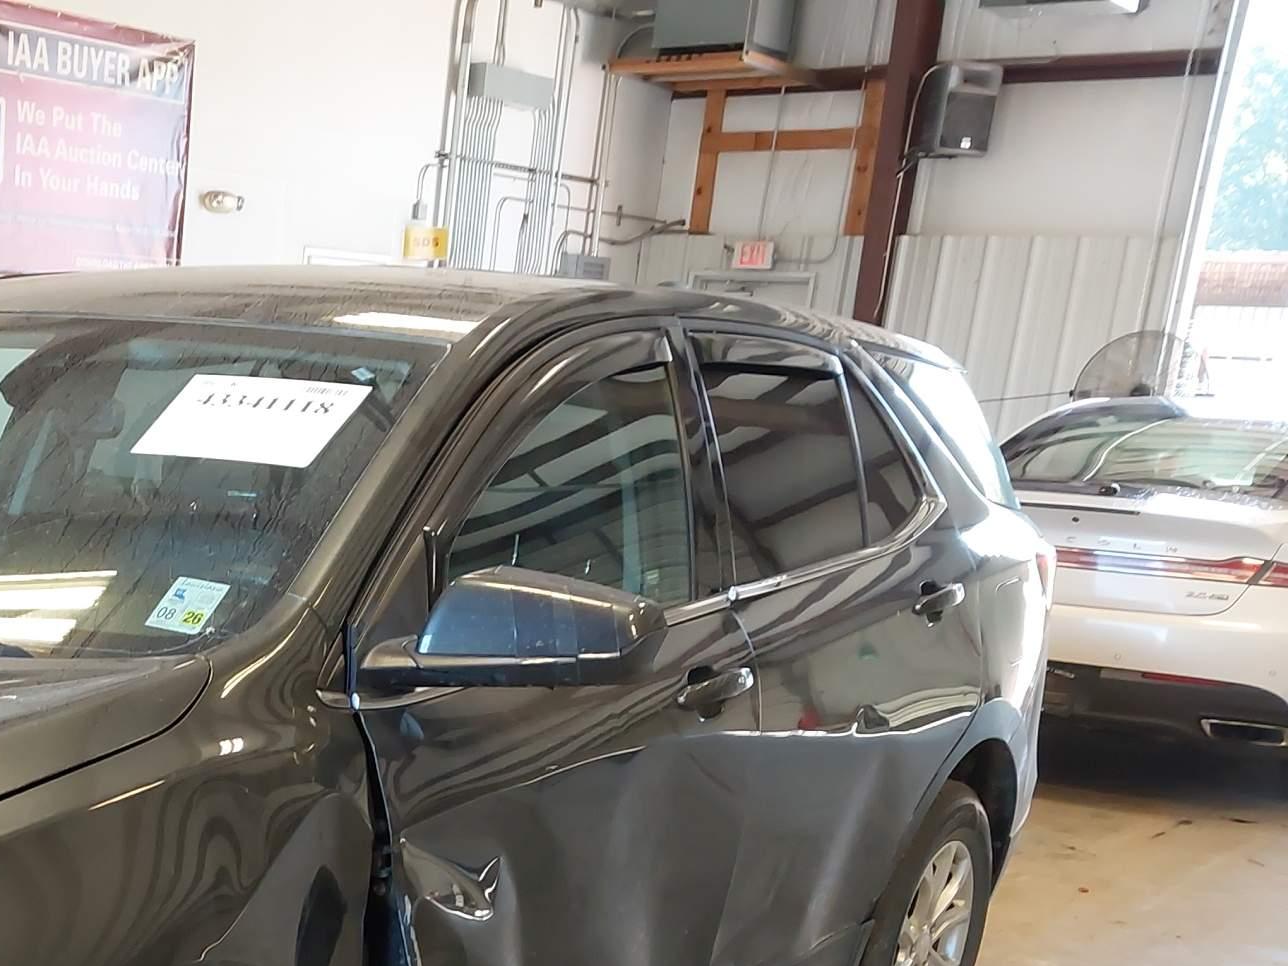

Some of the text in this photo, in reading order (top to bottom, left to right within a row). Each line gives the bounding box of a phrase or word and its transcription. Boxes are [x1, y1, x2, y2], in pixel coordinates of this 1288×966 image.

[7, 30, 49, 72] IAA
[57, 41, 130, 87] BUYER
[137, 54, 180, 94] APP
[17, 99, 122, 138] We Put The
[15, 131, 50, 157] IAA
[55, 139, 122, 168] Auction
[127, 150, 185, 178] Center
[15, 164, 140, 200] In Your Hands
[156, 606, 204, 625] 08 26
